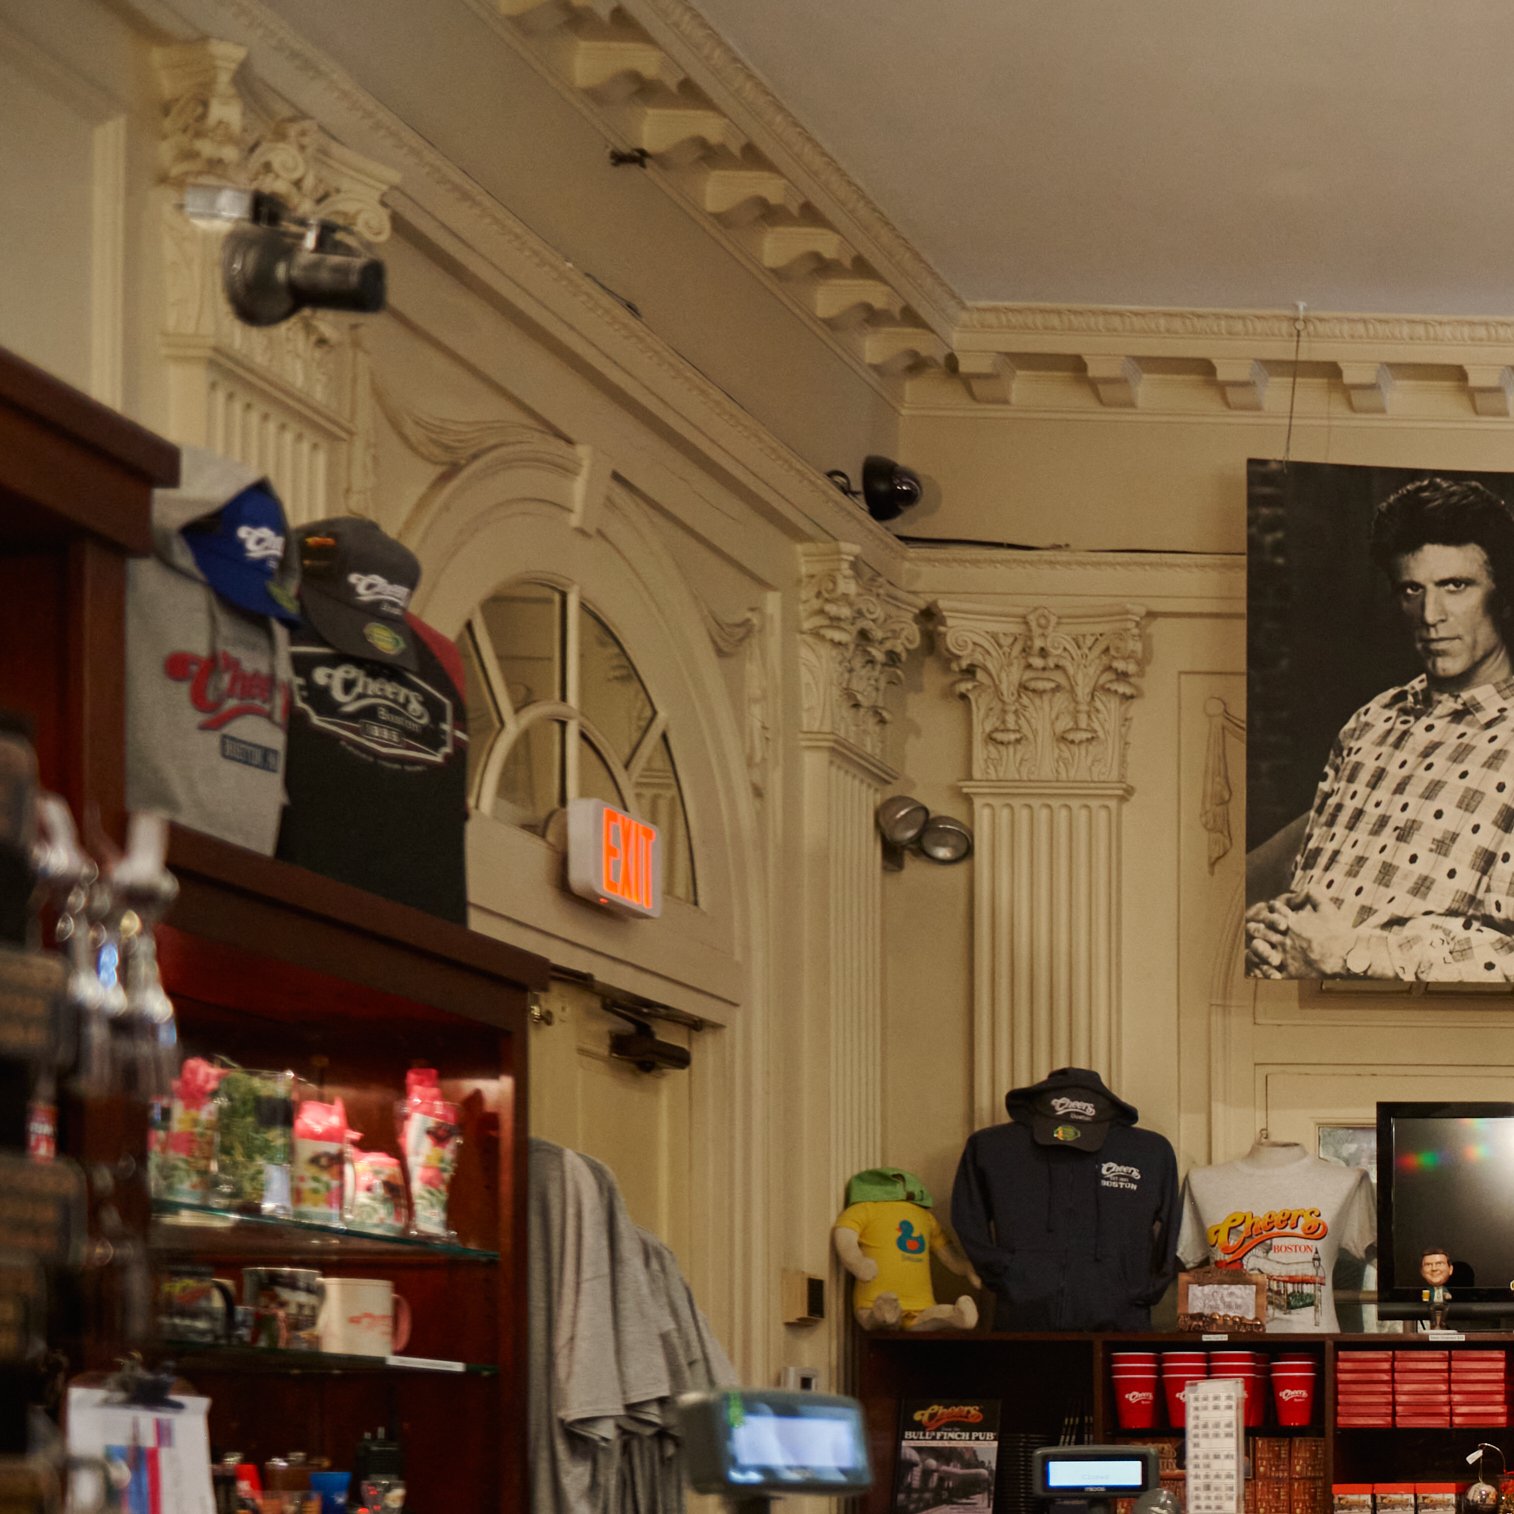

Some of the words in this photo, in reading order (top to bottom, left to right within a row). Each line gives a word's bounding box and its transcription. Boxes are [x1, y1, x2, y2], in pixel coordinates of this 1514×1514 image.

[312, 664, 430, 725] Cheers
[603, 807, 656, 909] EXIT
[1051, 1097, 1096, 1117] Cheers
[1101, 1161, 1142, 1180] Cheers
[1101, 1179, 1138, 1190] BOSTON
[1206, 1208, 1329, 1264] Cheers
[1273, 1244, 1313, 1254] BOSTON
[913, 1404, 983, 1431] Cheers
[904, 1431, 931, 1441] BULL
[936, 1431, 969, 1441] FINCH
[971, 1431, 995, 1441] PUB
